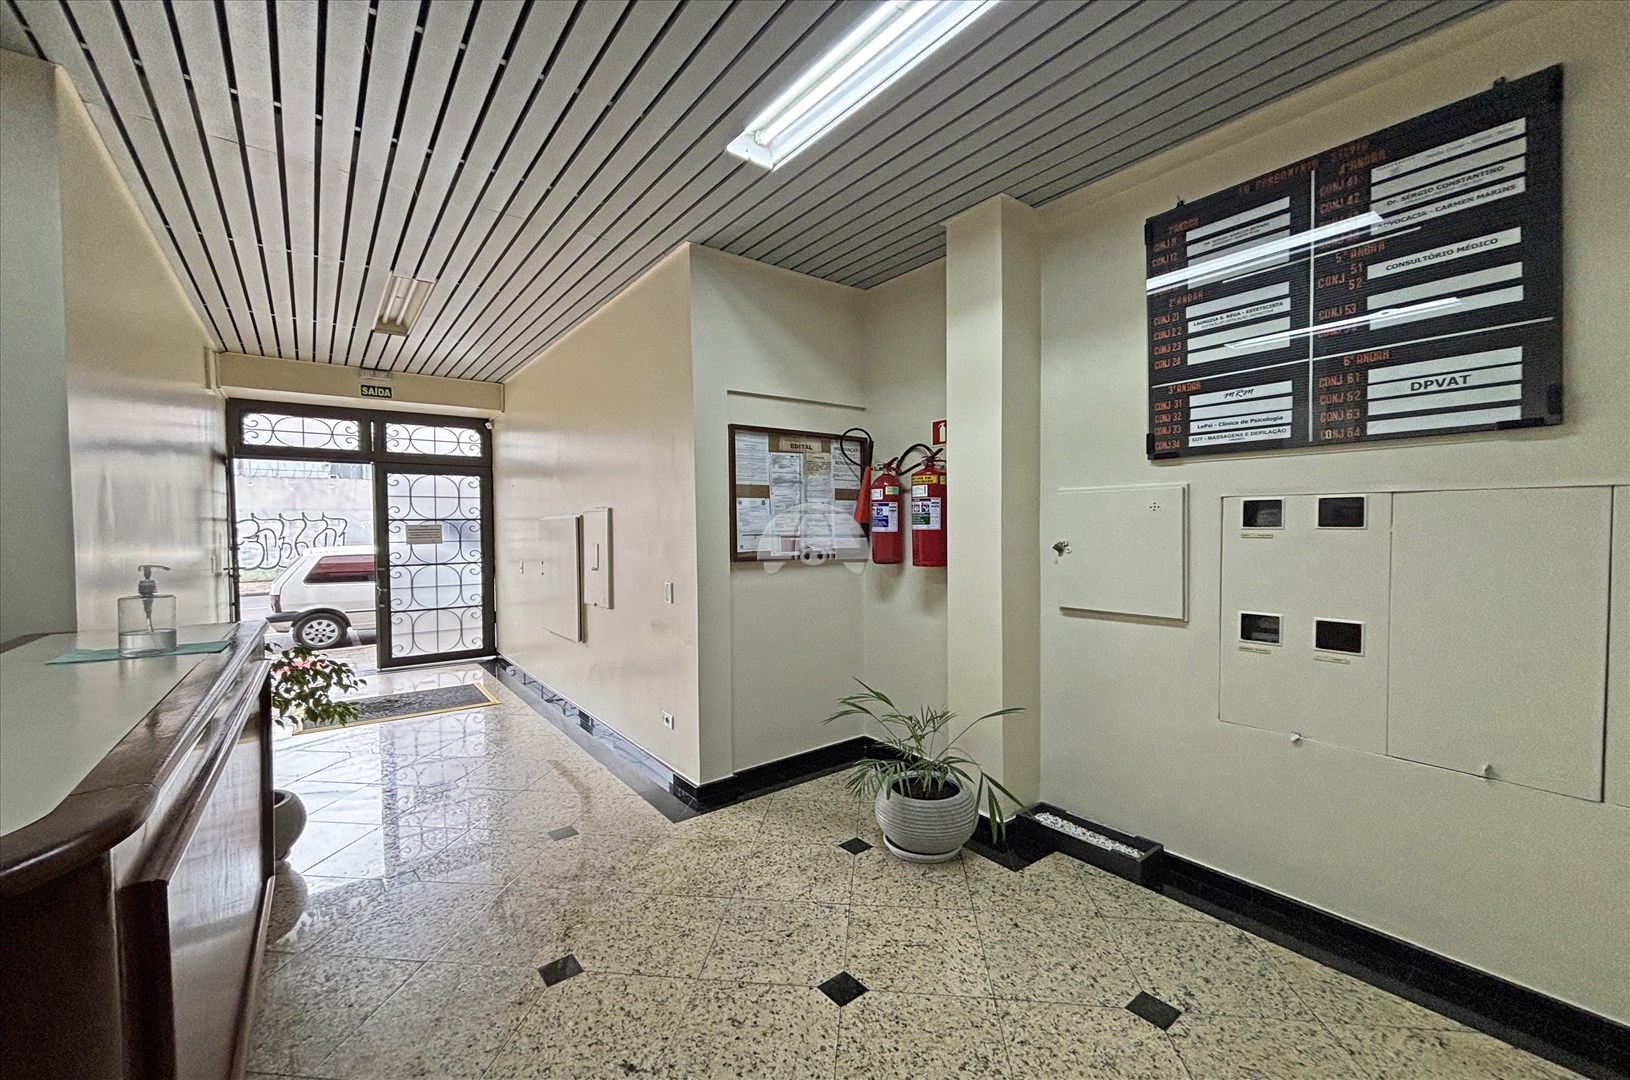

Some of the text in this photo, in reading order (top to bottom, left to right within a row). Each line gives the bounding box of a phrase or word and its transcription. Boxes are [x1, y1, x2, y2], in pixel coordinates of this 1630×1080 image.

[1436, 165, 1505, 191] CONSTANTINO
[1435, 196, 1474, 212] CARMEN
[1477, 184, 1516, 200] MARINS
[1320, 198, 1344, 214] CONJ
[1386, 238, 1499, 271] CONSULTÓRIO MÉDICO
[1350, 263, 1363, 274] 51
[1317, 273, 1345, 289] CONJ
[1246, 302, 1283, 314] ESTETICISTA
[1318, 303, 1357, 320] CONJ 53
[1153, 312, 1180, 326] CONJ 21
[1154, 327, 1182, 340] CONJ 22
[1154, 342, 1182, 355] CONJ 23
[1154, 359, 1171, 370] CONJ
[1319, 372, 1360, 387] CONJ 61
[1411, 374, 1472, 391] DPVAT
[362, 386, 391, 397] SAÍDA
[1320, 391, 1360, 405] CONJ 62
[1154, 399, 1182, 411] CONJ 31
[1154, 412, 1182, 423] CONJ 32
[1250, 415, 1284, 425] Psicologia
[1320, 409, 1360, 422] CONJ 63
[1154, 424, 1182, 436] CONJ 33
[1207, 432, 1244, 441] MASSAGENS
[1250, 428, 1287, 437] DEPILAÇÃO
[1321, 429, 1344, 440] CONJ
[1155, 441, 1171, 450] CONJ
